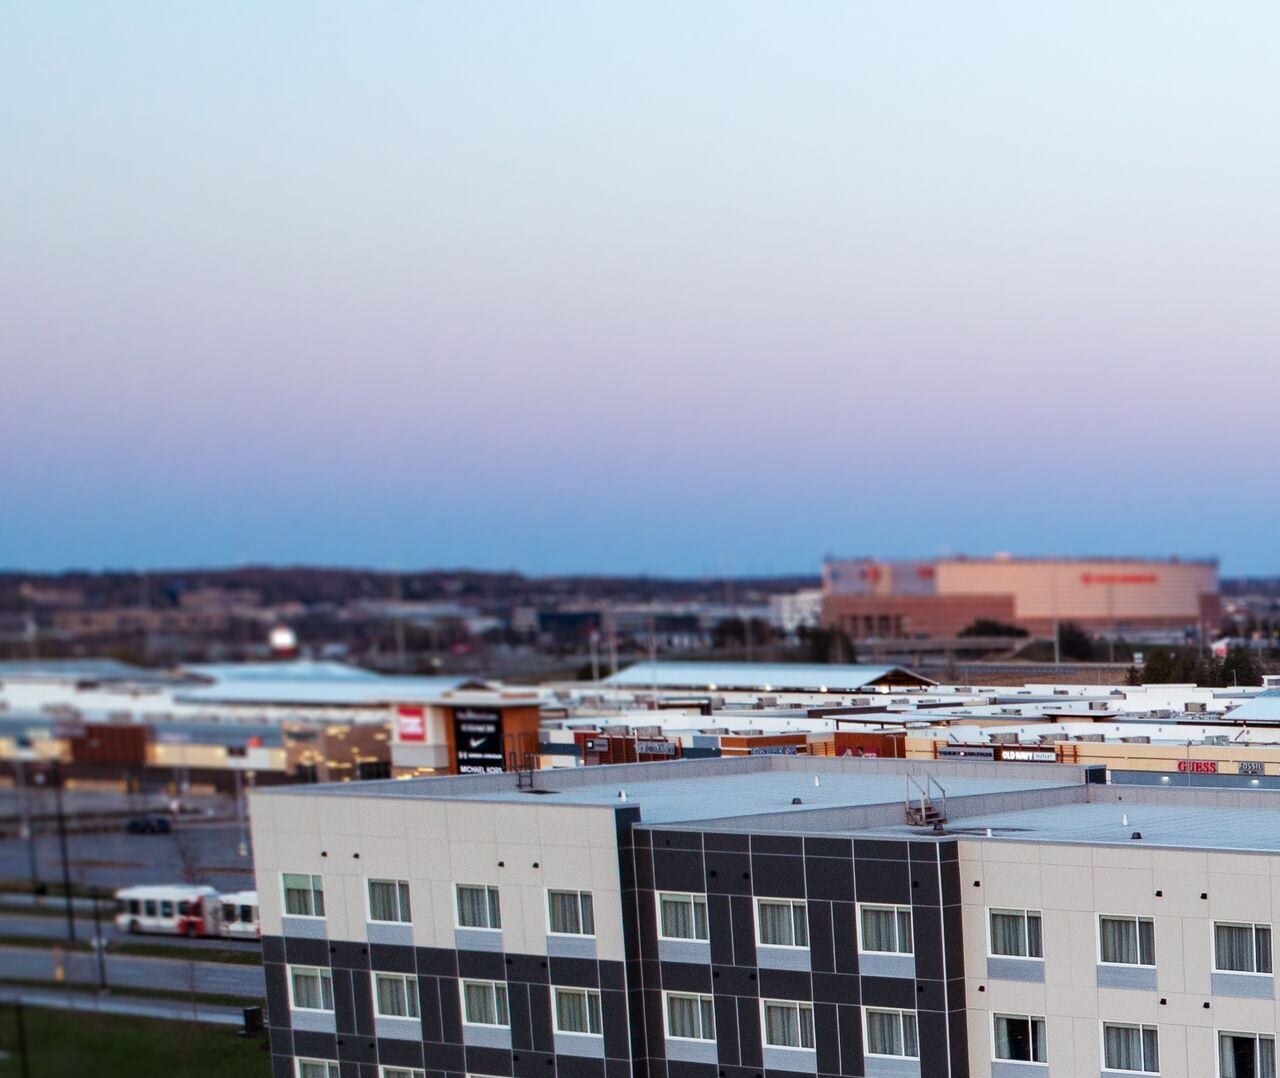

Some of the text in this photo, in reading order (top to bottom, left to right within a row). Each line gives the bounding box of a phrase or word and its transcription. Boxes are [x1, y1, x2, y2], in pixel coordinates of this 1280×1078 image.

[1002, 751, 1016, 760] OLD
[1016, 751, 1033, 760] NAVY
[1239, 762, 1262, 770] FOSSIL
